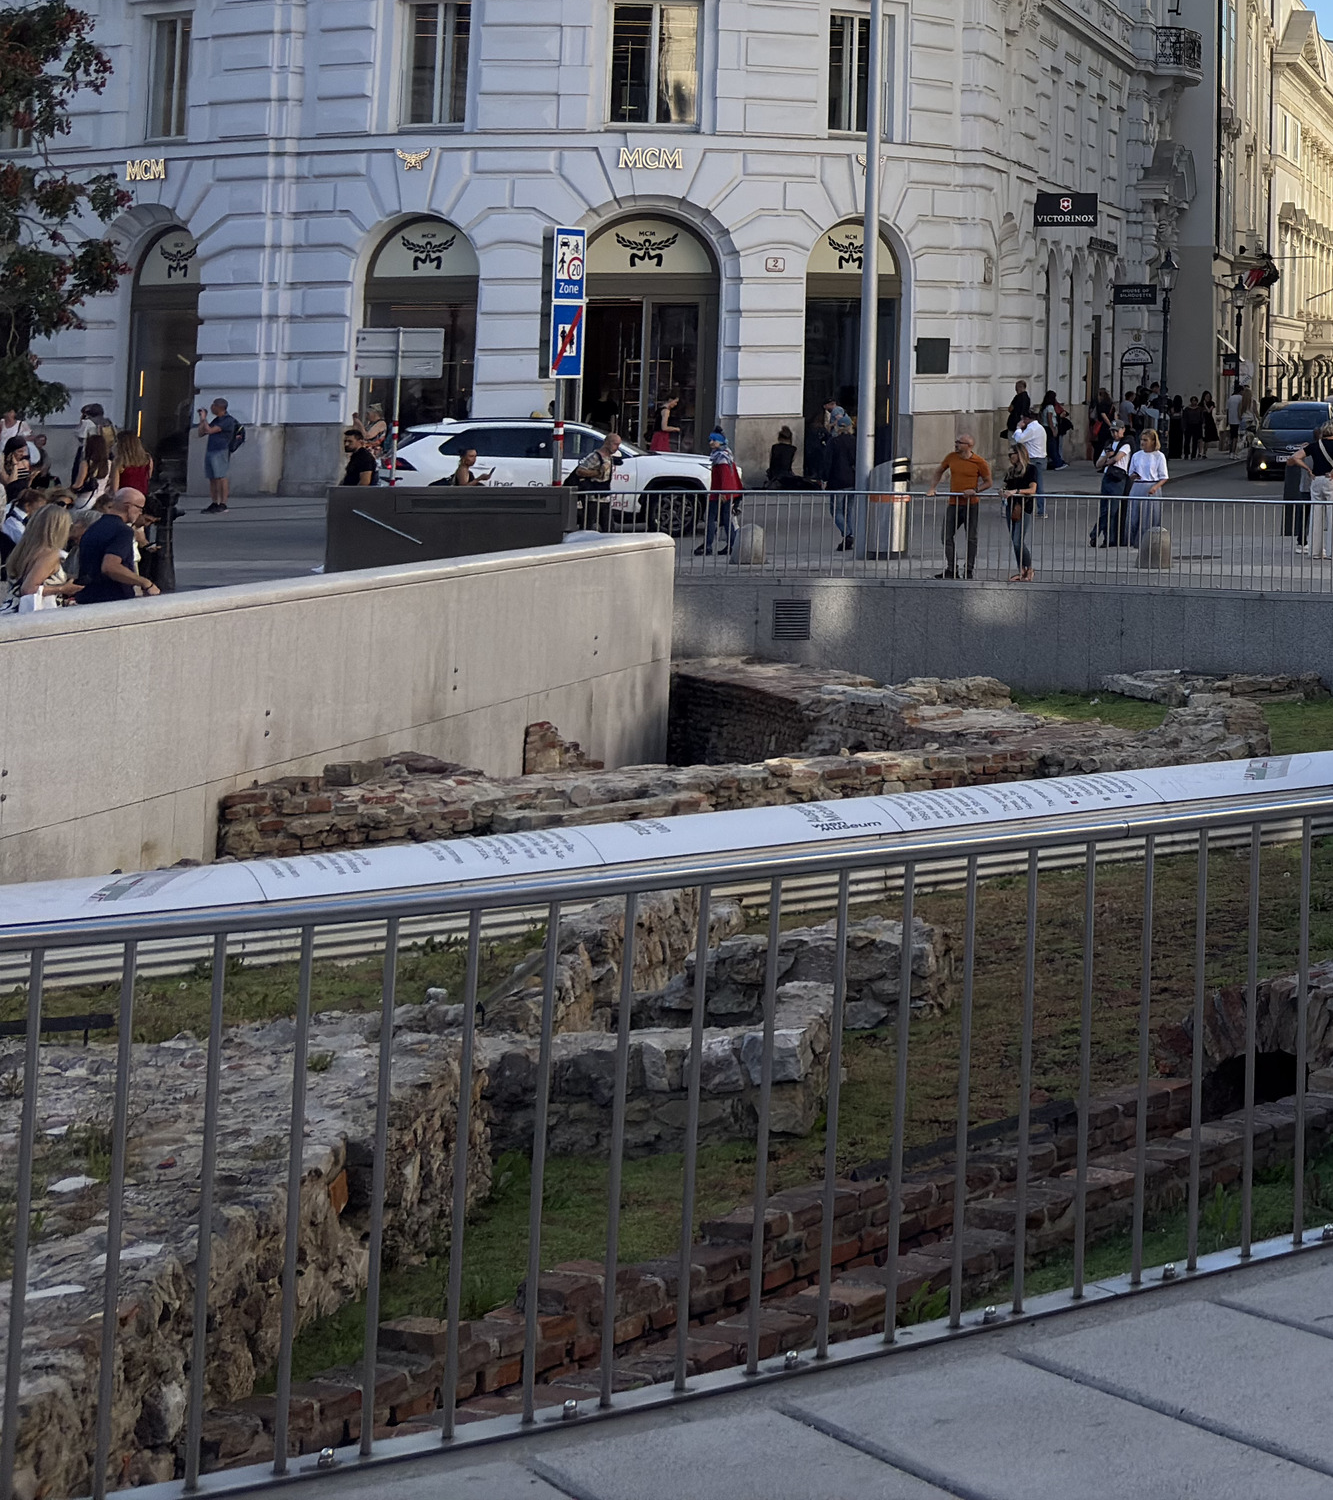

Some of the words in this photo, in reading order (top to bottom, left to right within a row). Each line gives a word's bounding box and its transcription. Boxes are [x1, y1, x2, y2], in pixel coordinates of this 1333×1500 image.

[618, 147, 683, 169] MCM
[125, 158, 166, 181] MCM
[1037, 214, 1095, 223] VICTORINOX
[571, 263, 581, 277] 20
[558, 282, 579, 294] Zone
